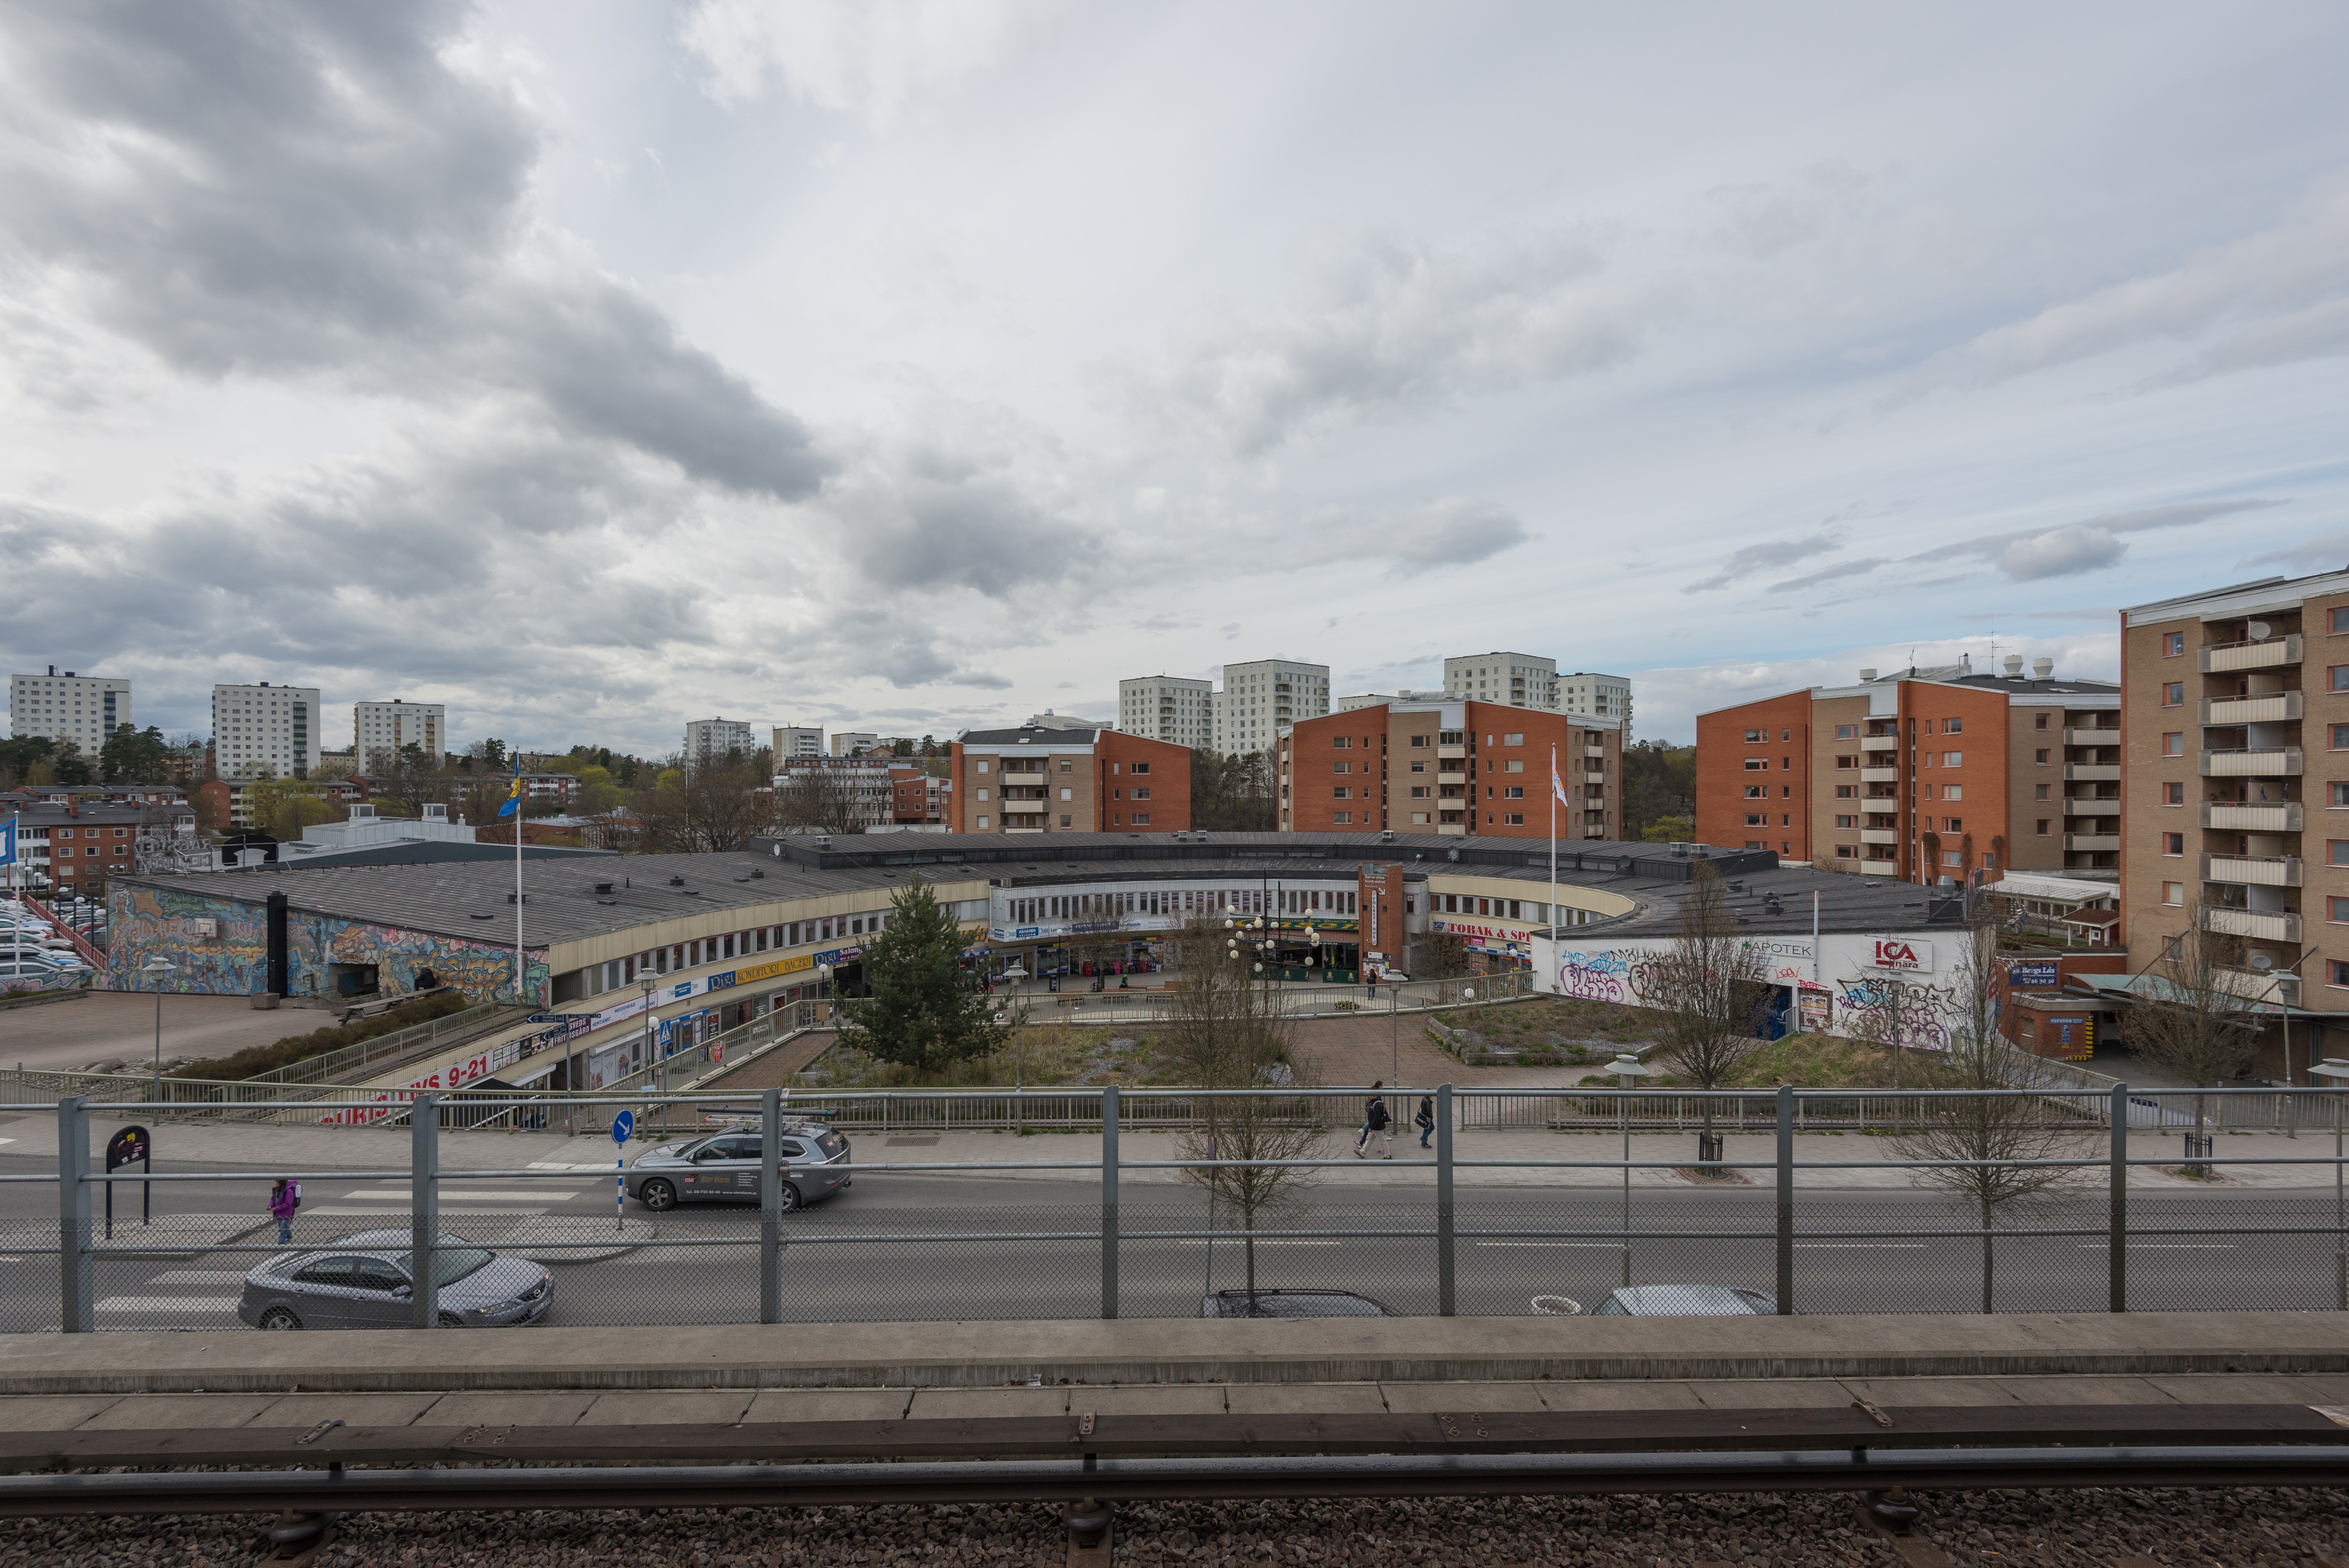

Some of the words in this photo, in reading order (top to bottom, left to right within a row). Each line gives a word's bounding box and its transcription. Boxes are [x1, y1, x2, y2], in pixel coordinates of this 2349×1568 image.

[1448, 923, 1493, 937] TOBAK
[1497, 928, 1506, 938] &
[839, 947, 863, 955] Salong
[1752, 942, 1812, 956] APOTEK
[1876, 941, 1918, 962] ICA
[710, 973, 735, 991] Rigi
[737, 963, 779, 981] KONDITORI
[785, 957, 812, 970] BAGERI
[815, 951, 837, 968] Rigi
[1895, 960, 1919, 969] nära
[614, 1002, 636, 1014] MEDIHEAD
[592, 1017, 611, 1027] HEMTJÄNST
[449, 1055, 487, 1087] 9-21
